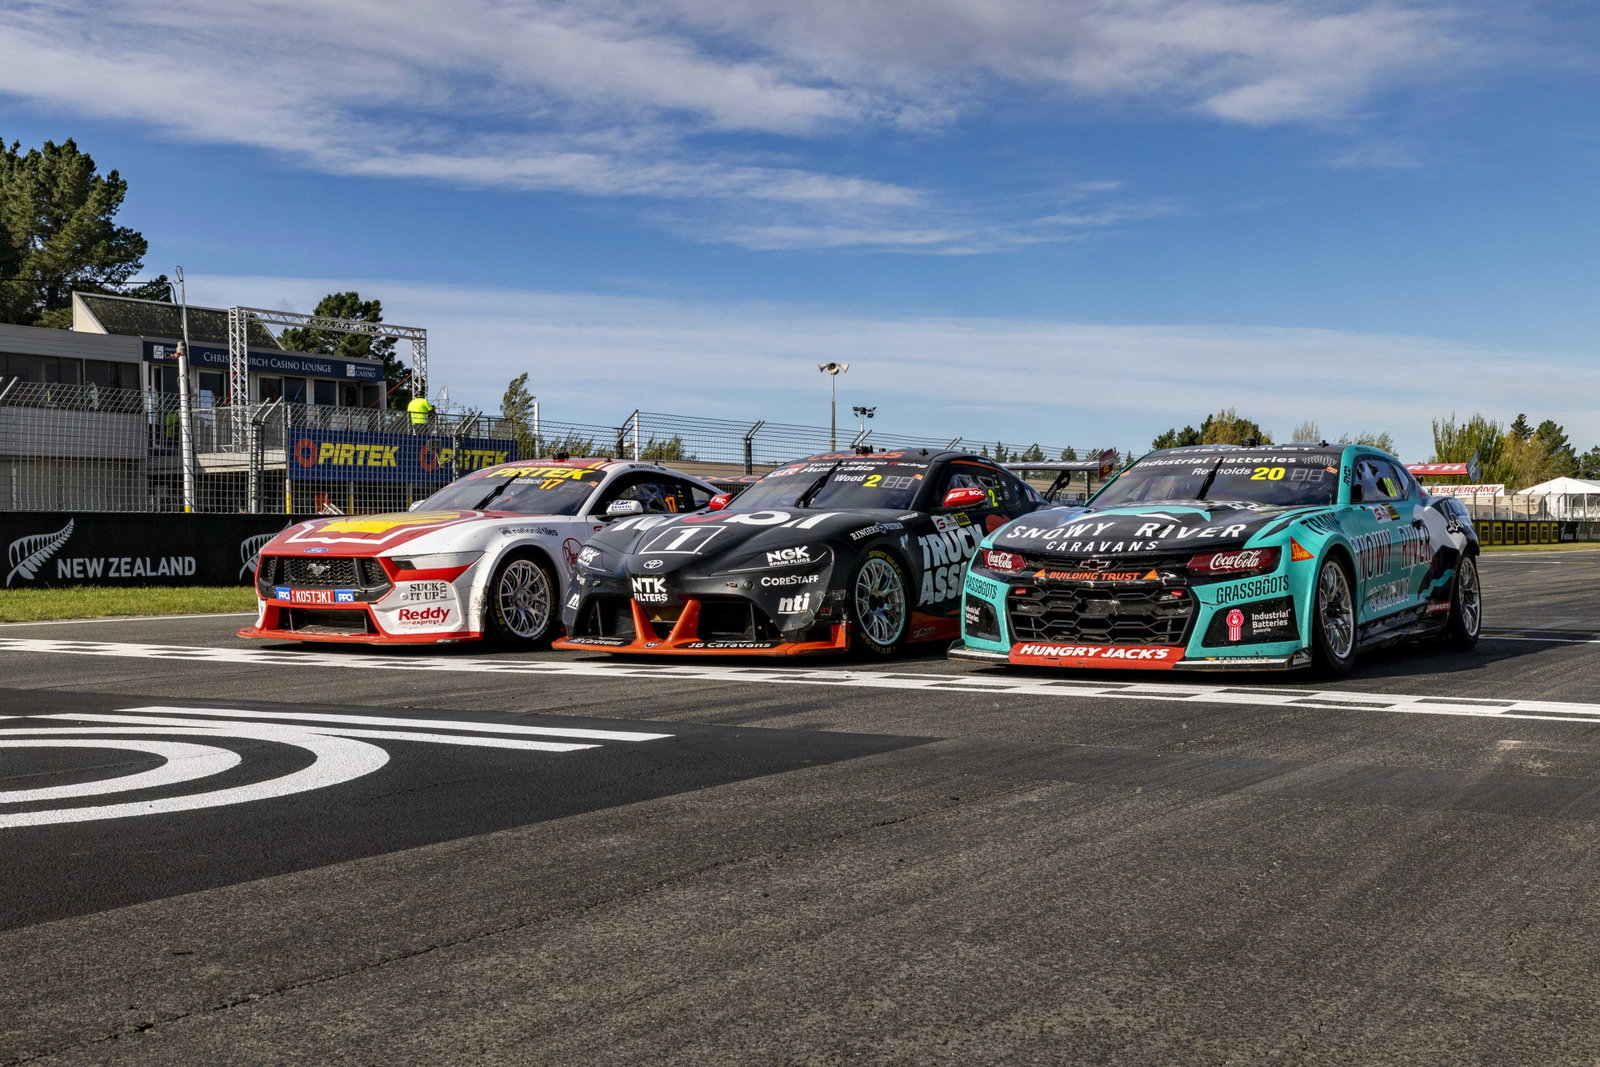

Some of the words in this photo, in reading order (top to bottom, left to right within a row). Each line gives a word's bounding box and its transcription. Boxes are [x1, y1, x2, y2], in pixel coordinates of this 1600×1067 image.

[203, 352, 268, 367] CHRISURCH
[270, 358, 300, 370] CASINO
[302, 361, 332, 373] LOUNGE
[318, 443, 399, 467] PIRTEK
[439, 448, 509, 470] PRTEK
[800, 465, 876, 473] Ausralia
[1136, 457, 1210, 468] Industrial
[485, 467, 596, 480] PIRTEK
[1192, 467, 1251, 476] Renolds
[1250, 467, 1286, 480] 20
[539, 479, 566, 490] 17
[834, 474, 867, 482] Wood
[862, 474, 882, 488] 2
[1441, 486, 1498, 494] SUPERDRIVE
[665, 496, 677, 513] 17
[988, 489, 999, 507] 2
[850, 525, 880, 541] RINGERS
[1007, 523, 1116, 539] SNOWY
[1134, 523, 1247, 539] RIVER
[664, 528, 697, 550] 1
[1046, 540, 1159, 552] CARAVANS
[766, 545, 809, 562] NGK
[918, 524, 984, 570] TRUCK
[58, 558, 105, 579] NEW
[108, 556, 196, 577] ZEALAND
[1049, 570, 1099, 580] BUILDING
[1101, 571, 1140, 581] TRUST
[410, 582, 439, 591] SUCK
[631, 577, 667, 593] NTK
[917, 561, 967, 606] ASSI
[410, 592, 421, 600] IT
[424, 591, 439, 600] UP
[634, 593, 668, 602] FILTERS
[777, 592, 810, 612] nti
[399, 607, 451, 622] Reddy
[1252, 610, 1289, 621] Industrial
[1252, 619, 1288, 628] Batteries
[1020, 645, 1102, 657] HUNGRY
[1101, 648, 1169, 659] JACK'S
